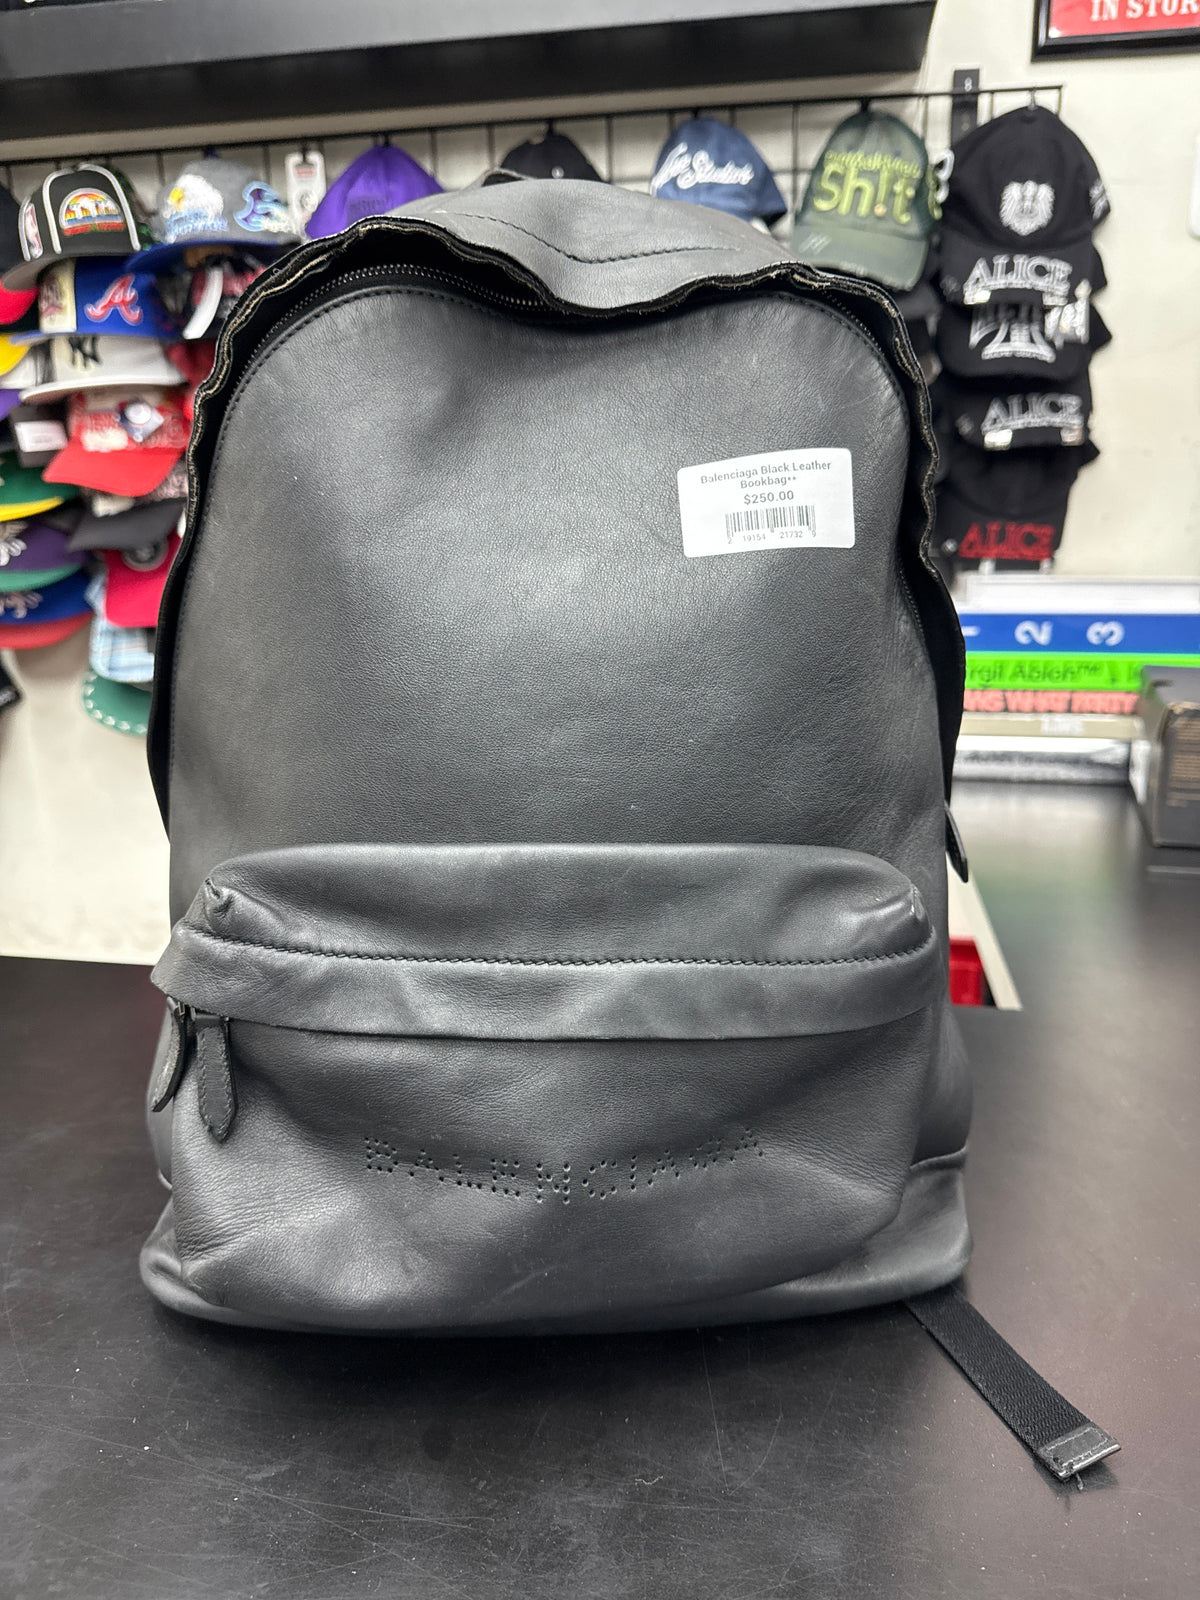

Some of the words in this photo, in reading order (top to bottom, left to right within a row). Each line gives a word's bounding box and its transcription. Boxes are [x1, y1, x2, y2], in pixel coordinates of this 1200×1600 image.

[1089, 0, 1119, 21] IN
[963, 254, 1073, 294] ALICE
[982, 394, 1083, 434] ALICE
[700, 468, 758, 484] Balenciaga
[760, 462, 790, 475] Black
[792, 460, 832, 472] Leather
[743, 490, 794, 505] $250.00
[742, 533, 766, 542] 19154
[780, 531, 803, 539] 21732
[959, 522, 1055, 561] ALICE
[1014, 620, 1053, 646] 2
[1086, 621, 1125, 646] 3
[364, 1128, 765, 1204] BALENCIAGA
